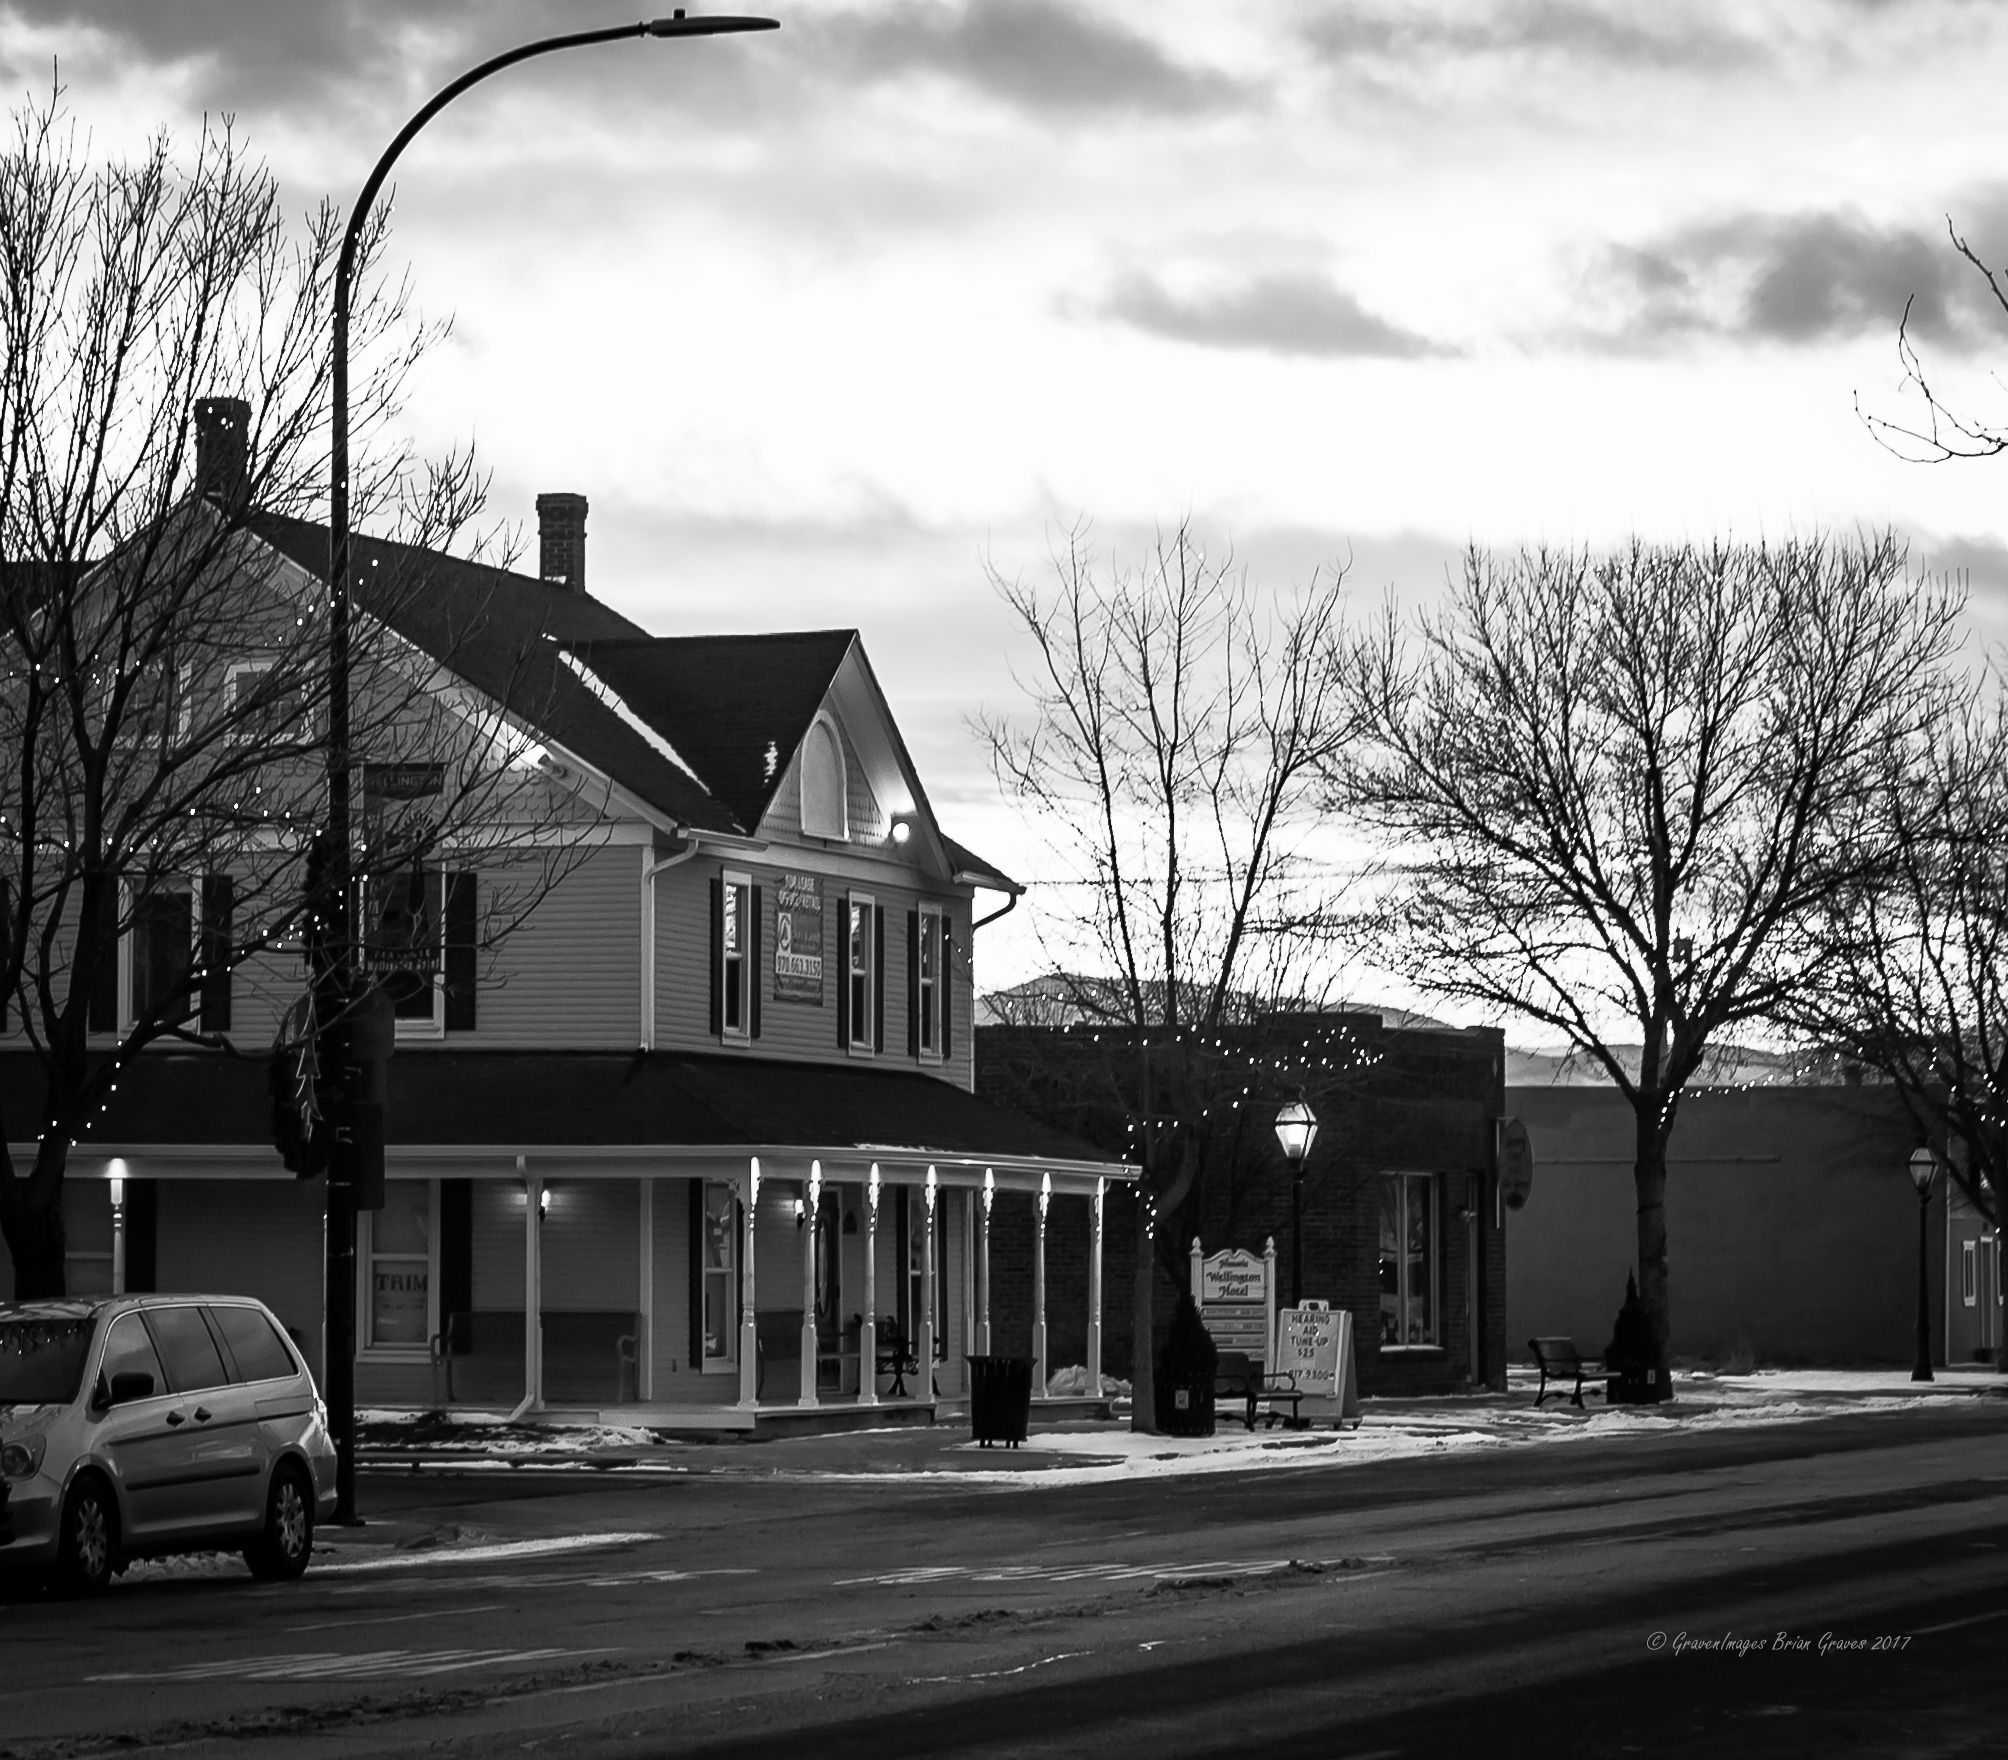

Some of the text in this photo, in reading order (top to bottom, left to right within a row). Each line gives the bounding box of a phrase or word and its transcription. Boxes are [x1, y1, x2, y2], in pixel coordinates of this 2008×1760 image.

[1206, 1270, 1261, 1285] Wellington
[1218, 1282, 1249, 1298] Hotel
[1291, 1314, 1330, 1325] HEARING
[1302, 1325, 1319, 1336] AID
[1290, 1335, 1329, 1347] TUNE-UP
